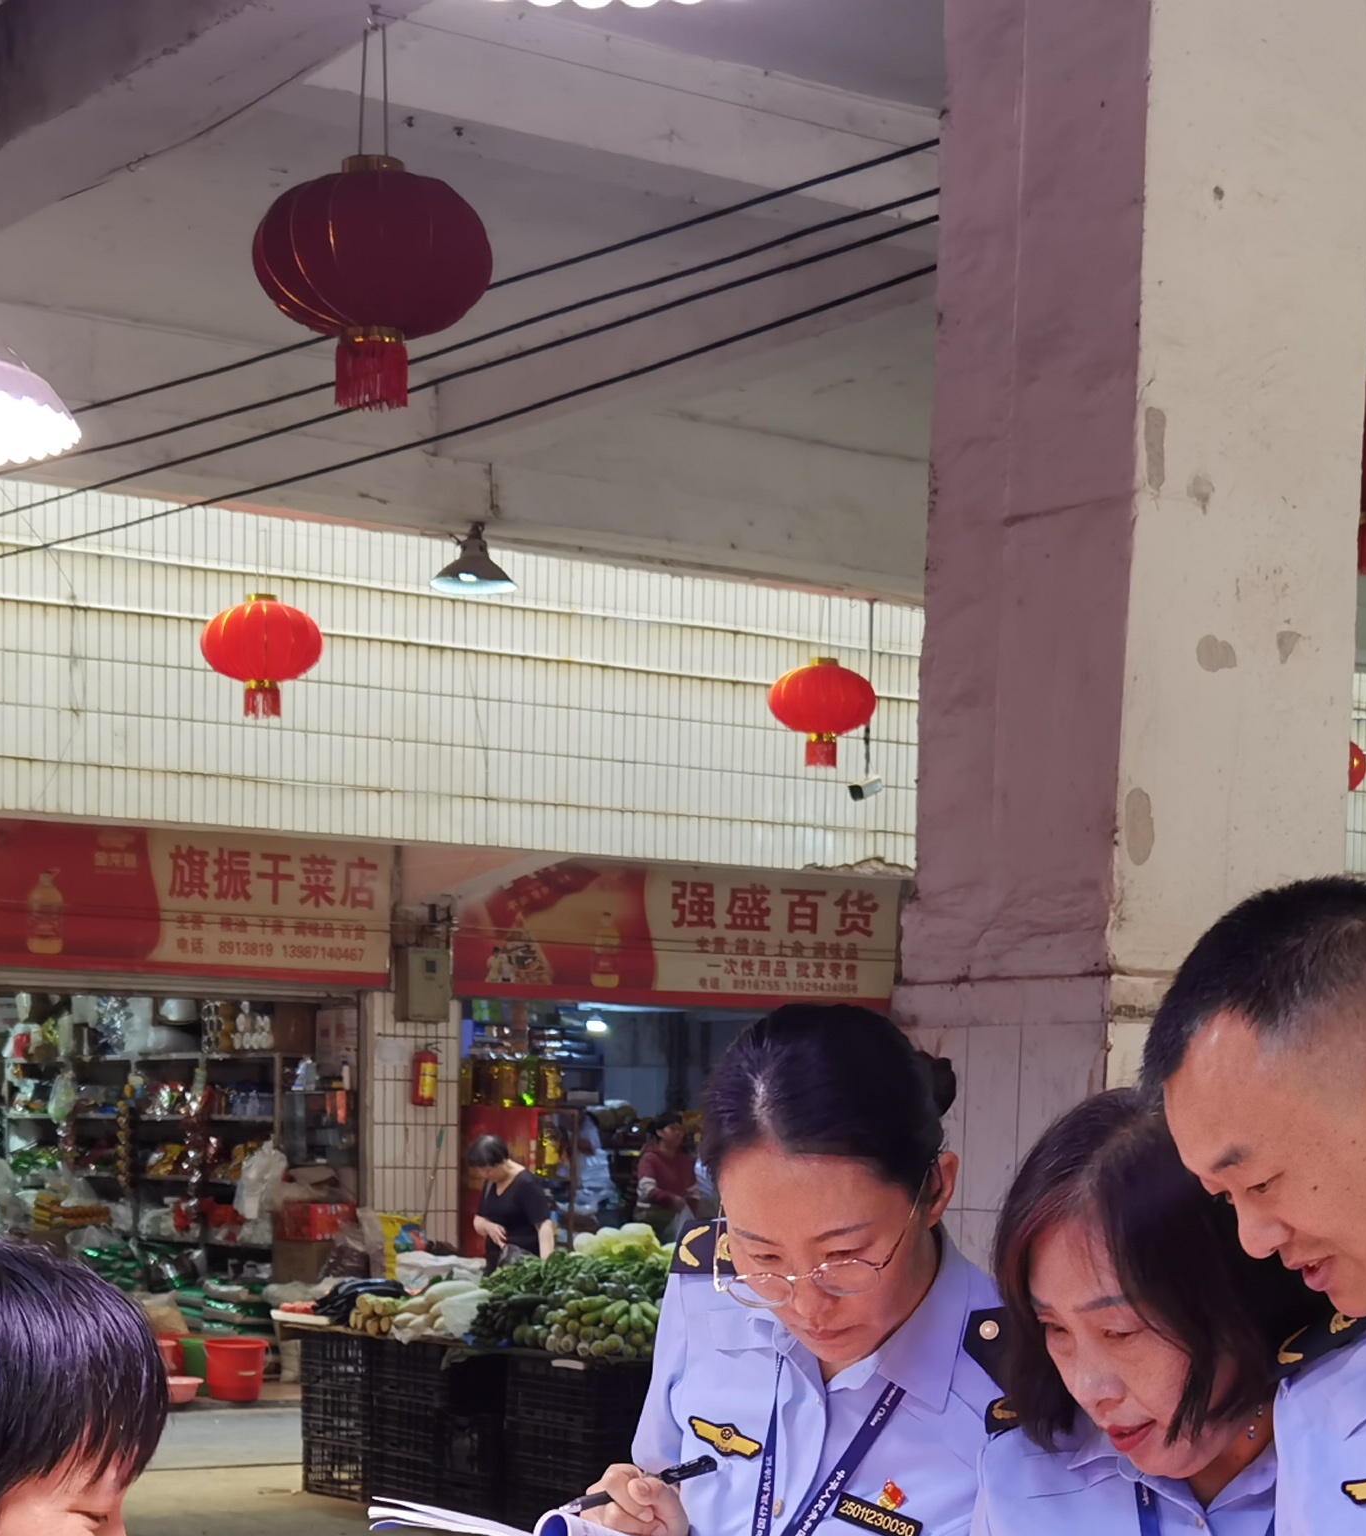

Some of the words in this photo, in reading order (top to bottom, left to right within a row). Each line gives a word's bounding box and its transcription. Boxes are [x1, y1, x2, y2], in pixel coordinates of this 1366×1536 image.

[168, 845, 378, 910] 旗振干菜店
[671, 881, 880, 938] 强盛百货
[218, 941, 274, 957] 8913819
[281, 944, 366, 961] 13987140467
[707, 958, 788, 978] 一次性用品
[796, 961, 858, 980] 批发零售
